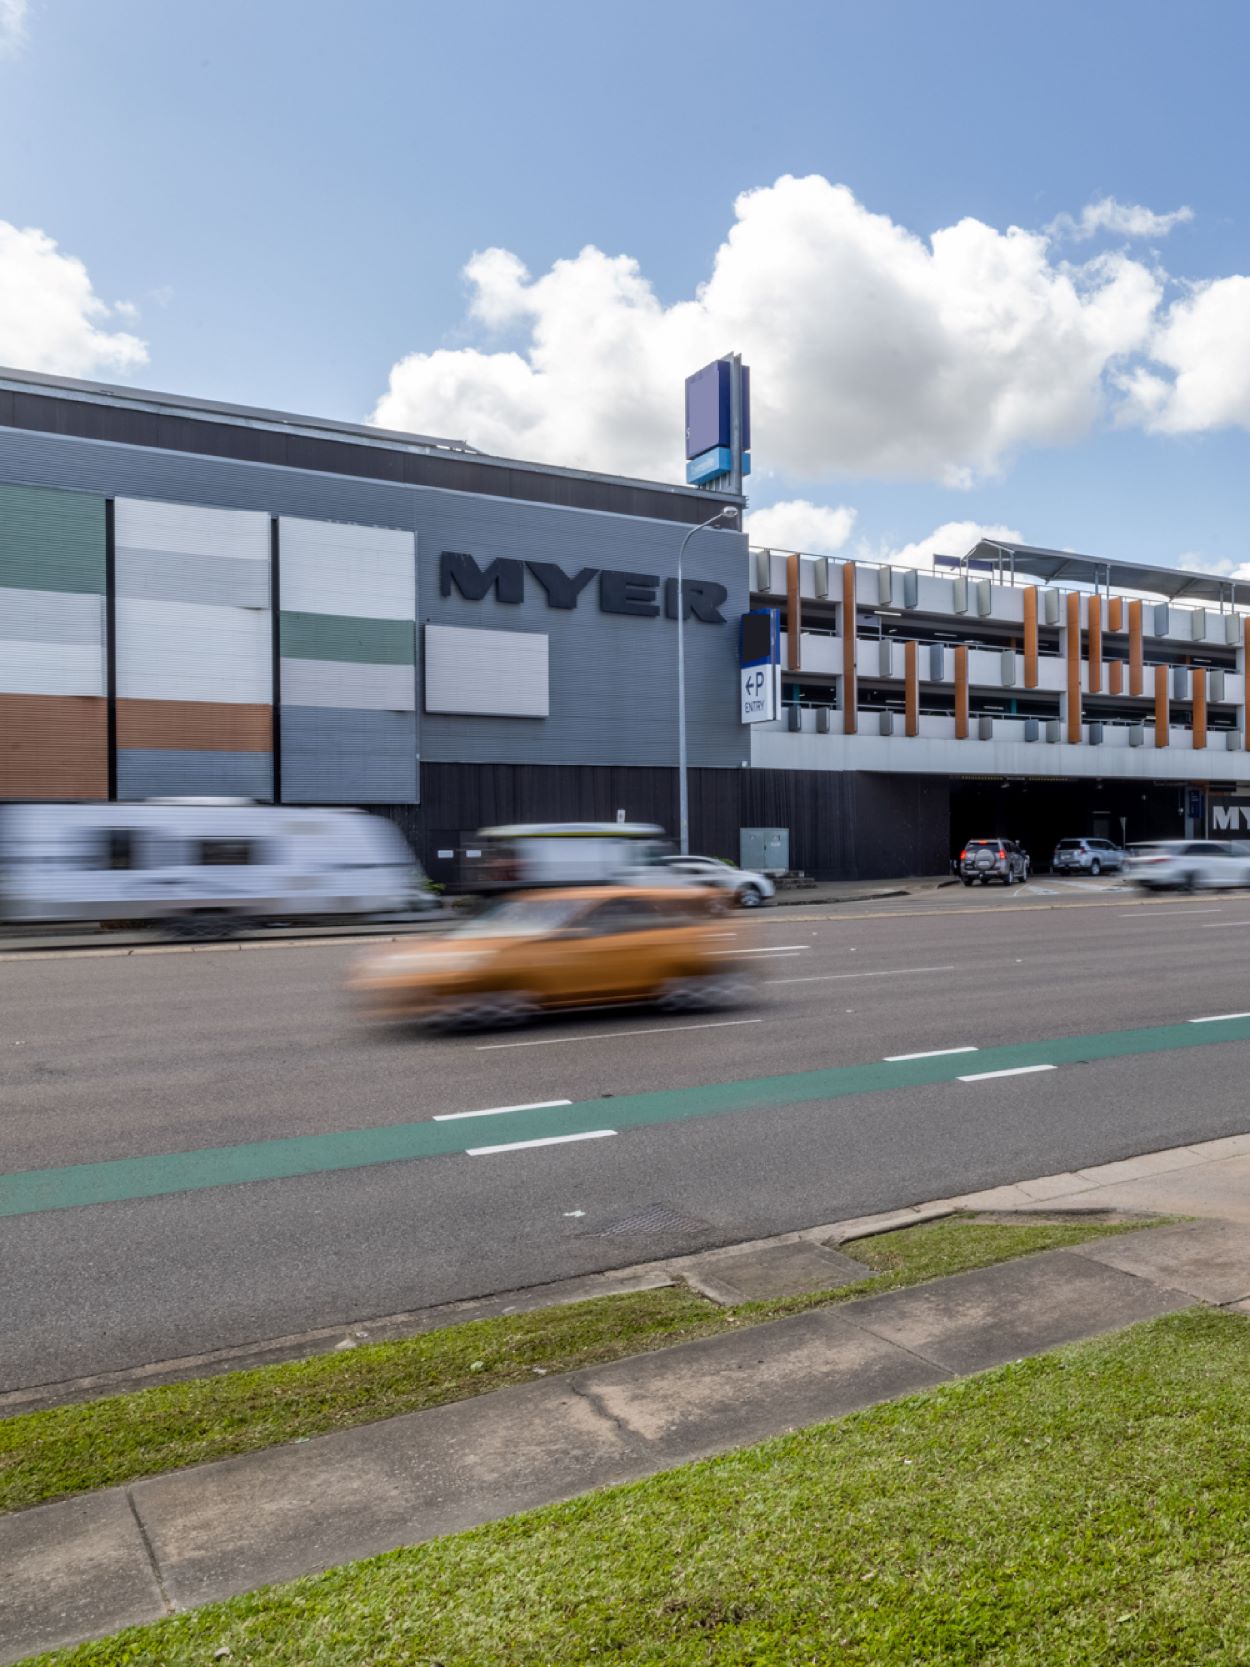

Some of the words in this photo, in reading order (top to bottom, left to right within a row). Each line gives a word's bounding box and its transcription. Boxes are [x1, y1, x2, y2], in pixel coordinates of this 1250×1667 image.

[439, 551, 728, 624] MYER
[755, 671, 765, 697] P
[745, 700, 765, 713] ENTRY
